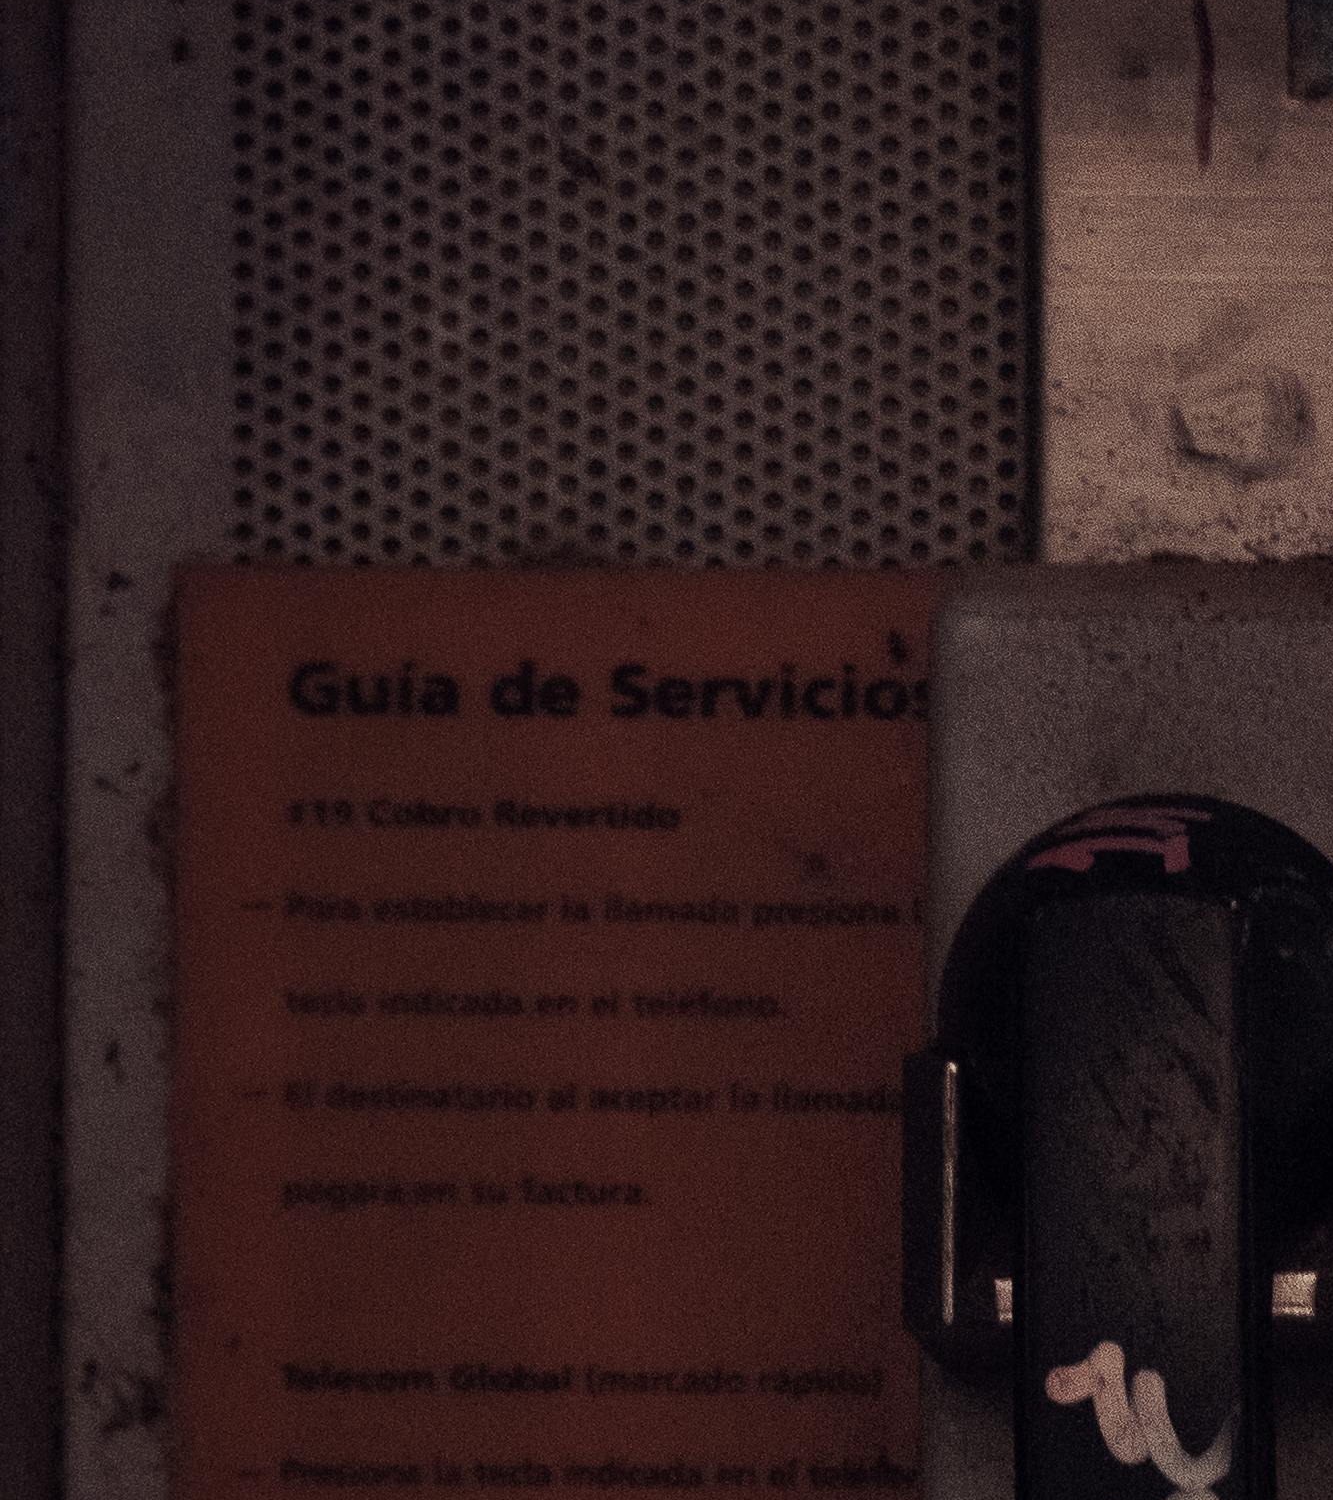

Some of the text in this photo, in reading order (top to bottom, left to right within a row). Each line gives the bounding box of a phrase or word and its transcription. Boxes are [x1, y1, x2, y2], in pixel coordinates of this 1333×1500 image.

[288, 658, 461, 717] Guía
[489, 659, 580, 717] de
[493, 800, 682, 831] Revertido
[283, 1364, 435, 1392] Telecom
[449, 1364, 573, 1394] Global
